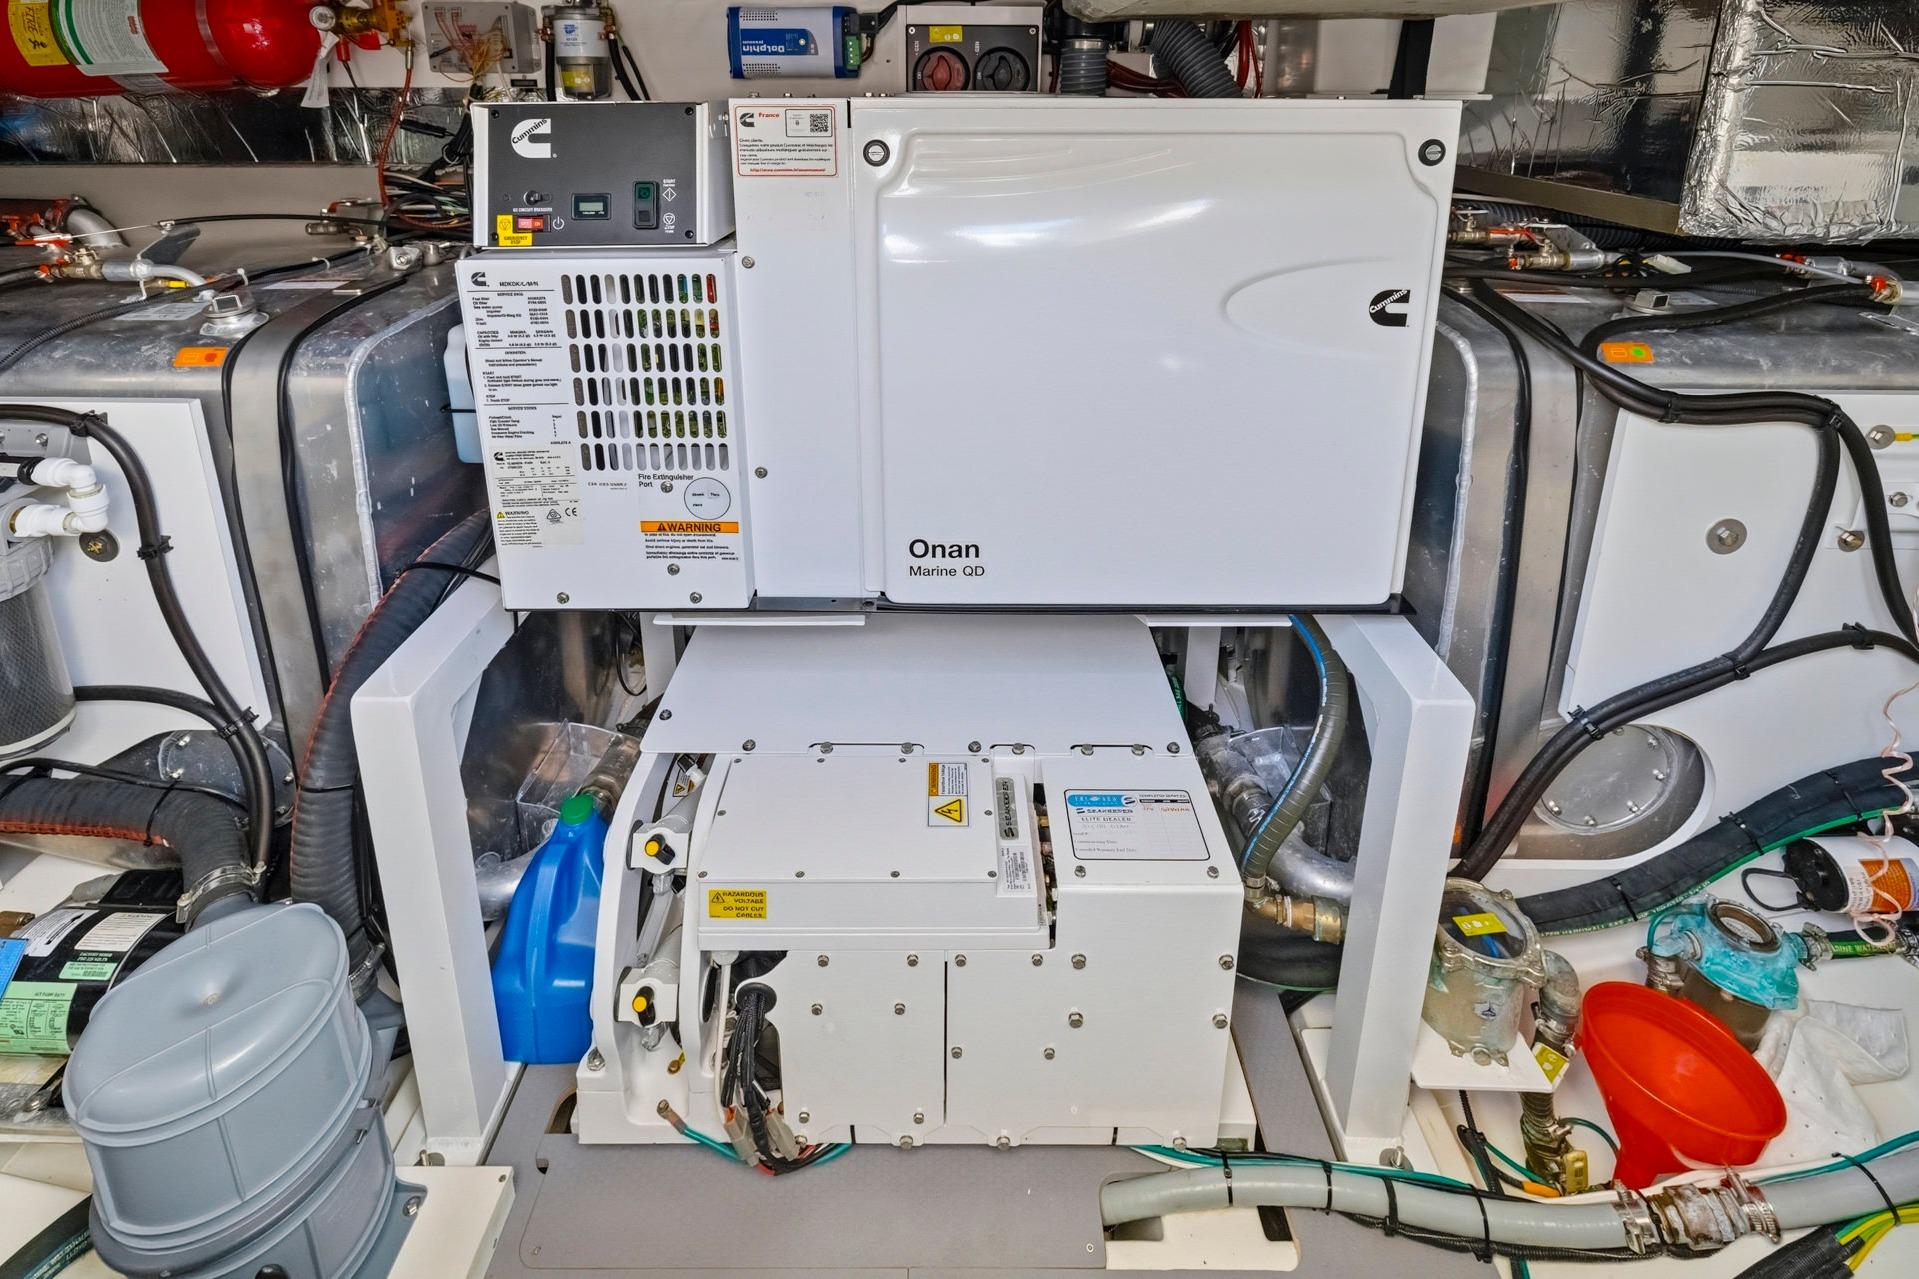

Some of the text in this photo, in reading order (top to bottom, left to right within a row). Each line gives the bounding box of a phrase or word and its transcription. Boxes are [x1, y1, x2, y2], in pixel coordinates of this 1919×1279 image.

[511, 118, 548, 145] Cummins
[1369, 289, 1408, 314] Cummins
[668, 523, 721, 532] WARNING
[909, 538, 980, 558] Onan
[910, 566, 985, 576] Marine QD
